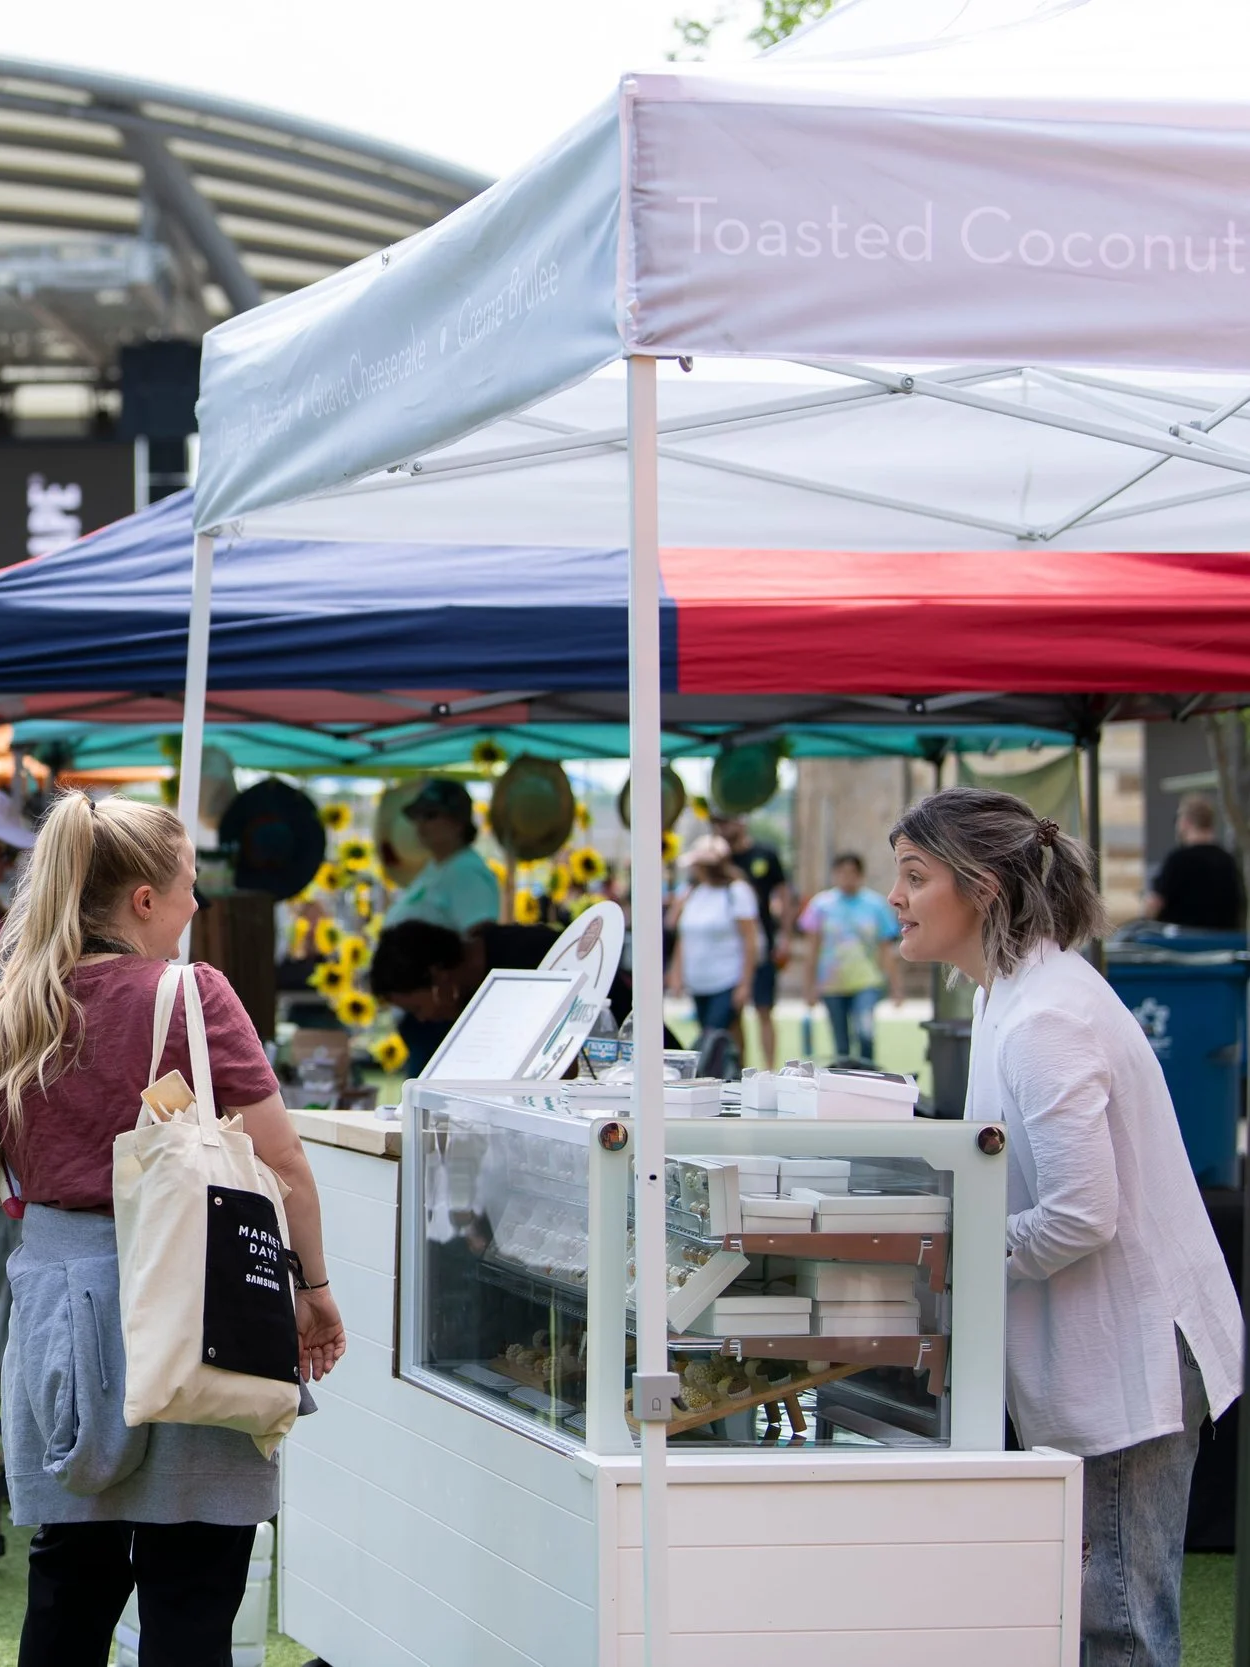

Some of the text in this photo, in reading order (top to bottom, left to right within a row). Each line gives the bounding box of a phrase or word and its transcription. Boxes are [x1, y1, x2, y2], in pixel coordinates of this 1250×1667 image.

[676, 196, 1246, 275] Toasted Coconut
[310, 249, 560, 419] Guava Cheesecake Creme Brulee
[239, 1225, 280, 1250] MARKET
[250, 1243, 277, 1261] DAYS
[246, 1274, 279, 1291] SAMSUNG
